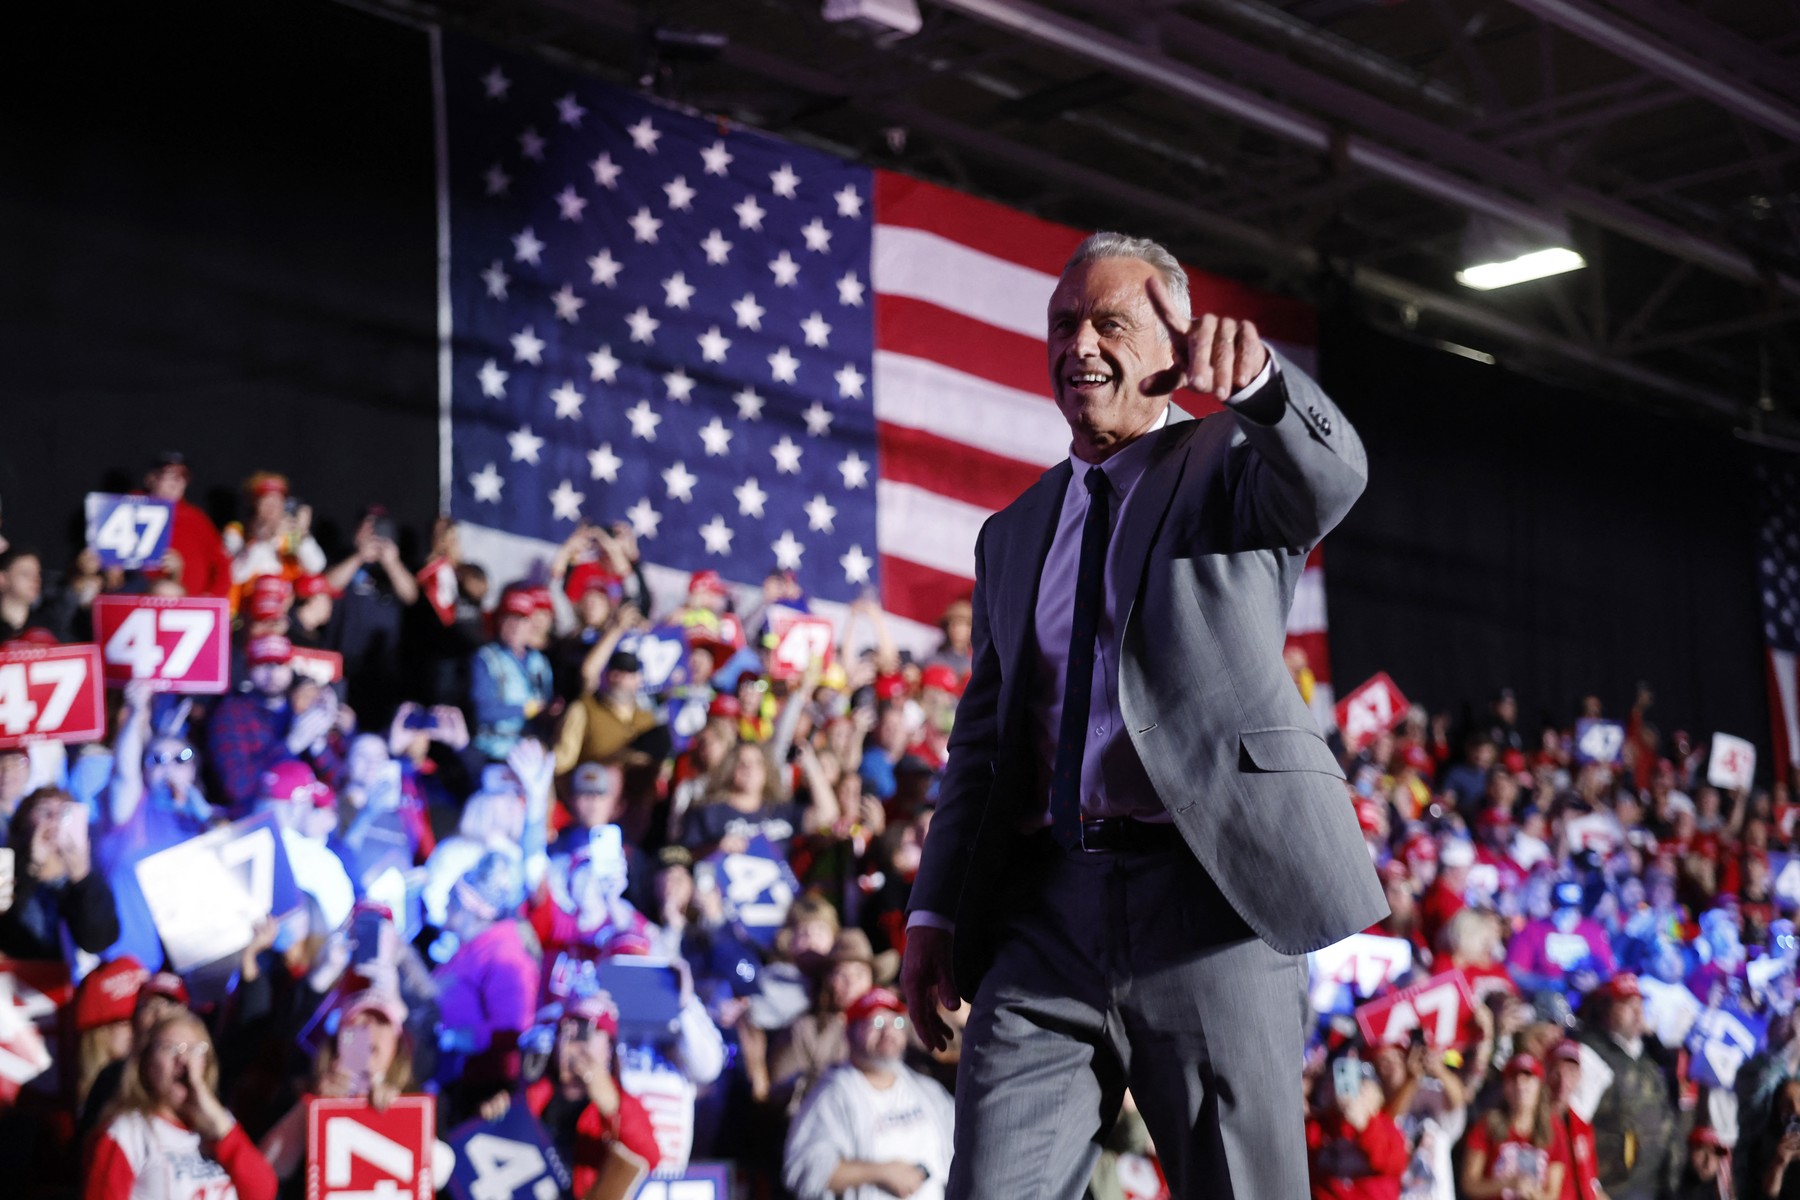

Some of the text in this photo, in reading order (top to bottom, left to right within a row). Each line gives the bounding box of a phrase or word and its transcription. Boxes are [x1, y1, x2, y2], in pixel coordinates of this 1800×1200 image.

[97, 503, 170, 561] 47
[105, 607, 216, 680] 47
[0, 658, 88, 737] 47
[1382, 980, 1459, 1048] 47
[464, 1132, 560, 1200] 4
